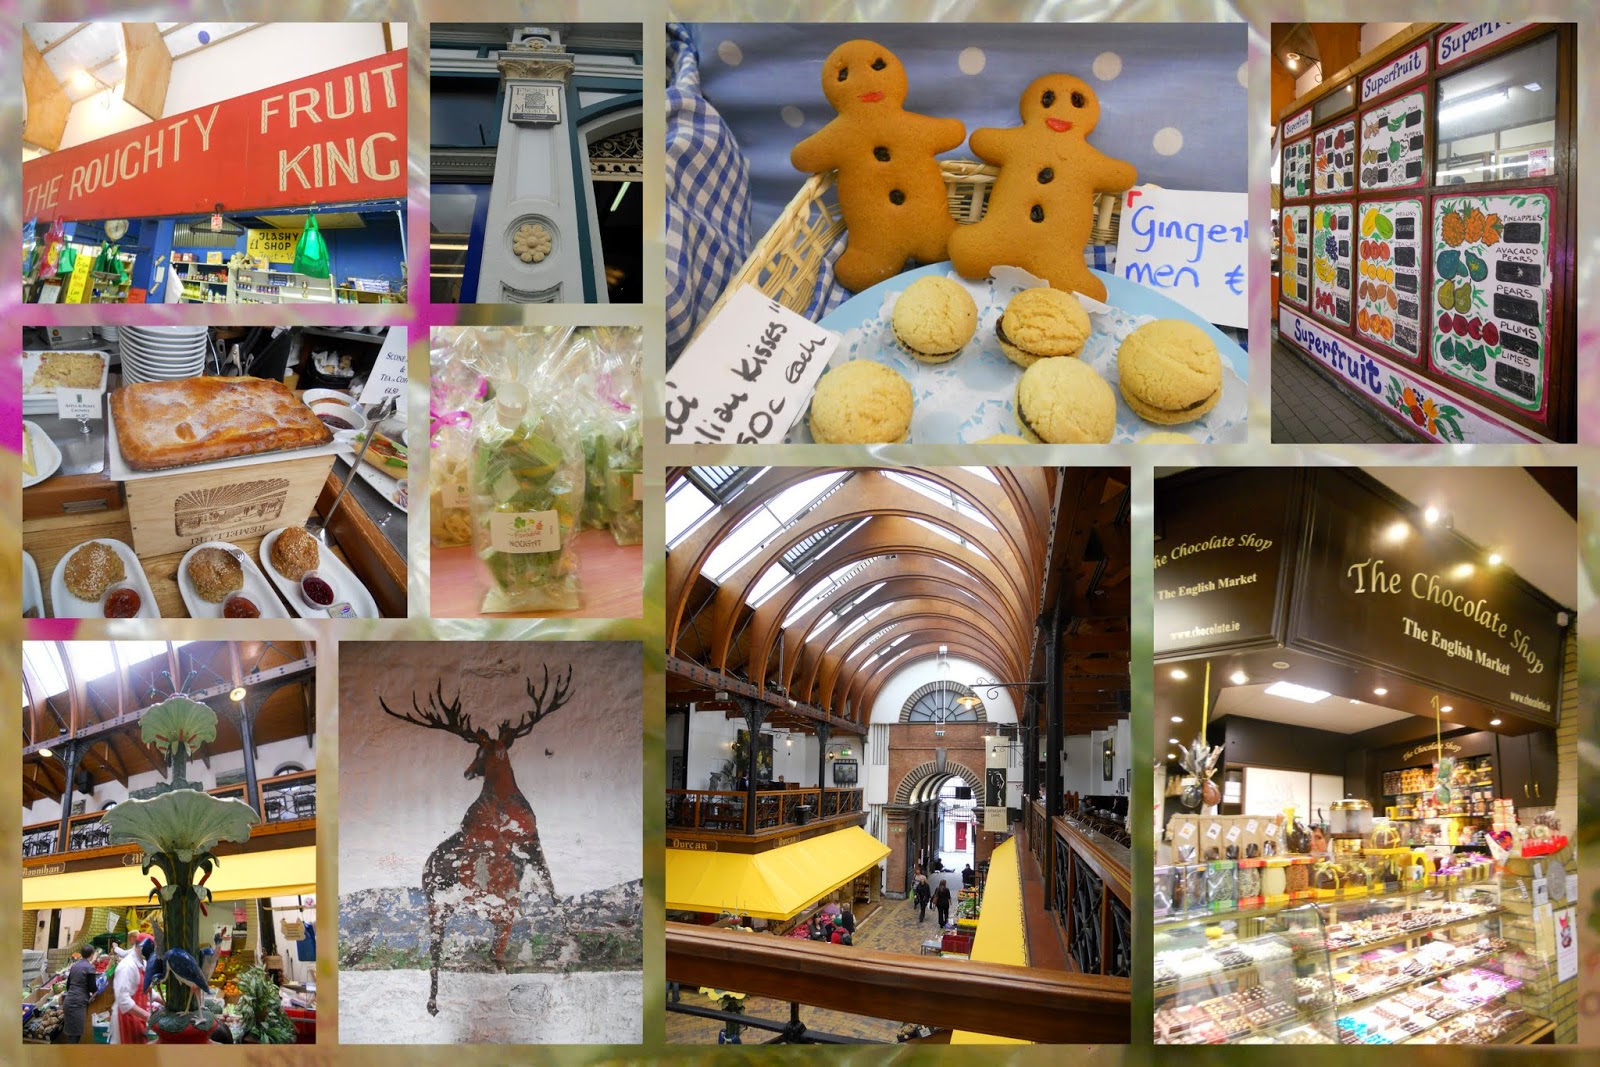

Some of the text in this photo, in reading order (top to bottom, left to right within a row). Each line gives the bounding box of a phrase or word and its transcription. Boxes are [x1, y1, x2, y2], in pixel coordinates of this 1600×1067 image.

[1441, 23, 1511, 60] Superf
[1364, 51, 1422, 98] Superfruit
[26, 62, 403, 216] THE ROUGHTY FRUIT
[278, 132, 400, 192] KING
[264, 242, 291, 250] SHOP
[1496, 247, 1538, 255] AVACADO
[1502, 254, 1533, 262] PEARS
[1125, 262, 1199, 288] men
[1496, 284, 1533, 299] PEARS
[1500, 320, 1537, 339] PLUMS
[386, 352, 408, 362] SCONE
[1294, 318, 1382, 394] Superfruit
[1501, 351, 1531, 367] LIMES
[1154, 533, 1273, 569] he Chocolate Shop
[1158, 572, 1257, 600] The English Market
[1347, 558, 1544, 674] The Chocolate Shop
[1170, 621, 1240, 640] www.chocolate.ie
[1402, 616, 1511, 676] The English Market
[1414, 742, 1443, 754] Chocolae
[1445, 742, 1462, 753] Shop
[673, 838, 708, 850] Durcan
